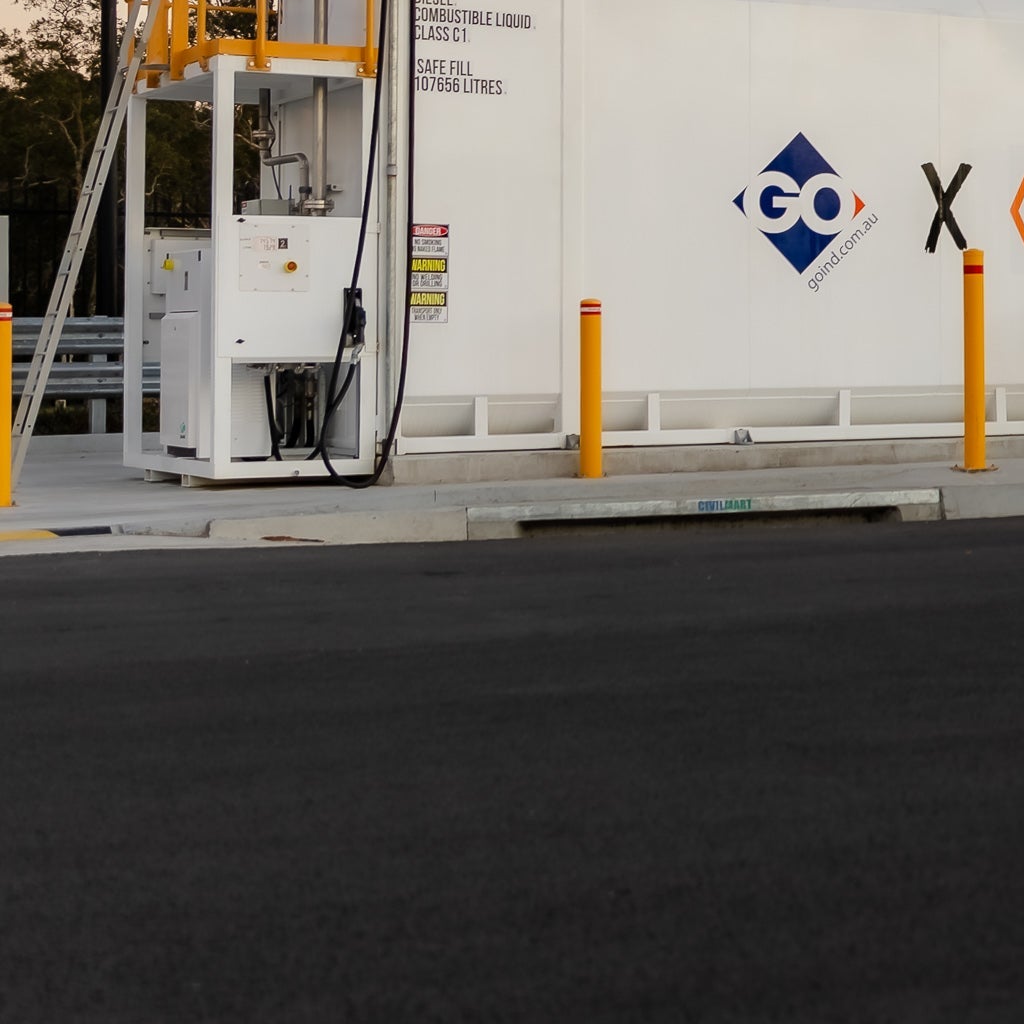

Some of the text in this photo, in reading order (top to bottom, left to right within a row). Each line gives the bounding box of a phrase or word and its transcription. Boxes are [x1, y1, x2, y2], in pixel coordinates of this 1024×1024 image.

[415, 7, 493, 26] COMBUSTIBLE
[415, 25, 449, 42] CLASS
[417, 59, 473, 76] SAFE FILL
[415, 76, 460, 93] 107656
[743, 171, 855, 236] GO
[920, 162, 973, 254] X
[415, 227, 442, 236] DANGER
[807, 213, 879, 292] goind.com.au
[412, 259, 446, 272] WARNING
[410, 293, 445, 306] WARNING
[698, 499, 751, 512] CIVILMART
